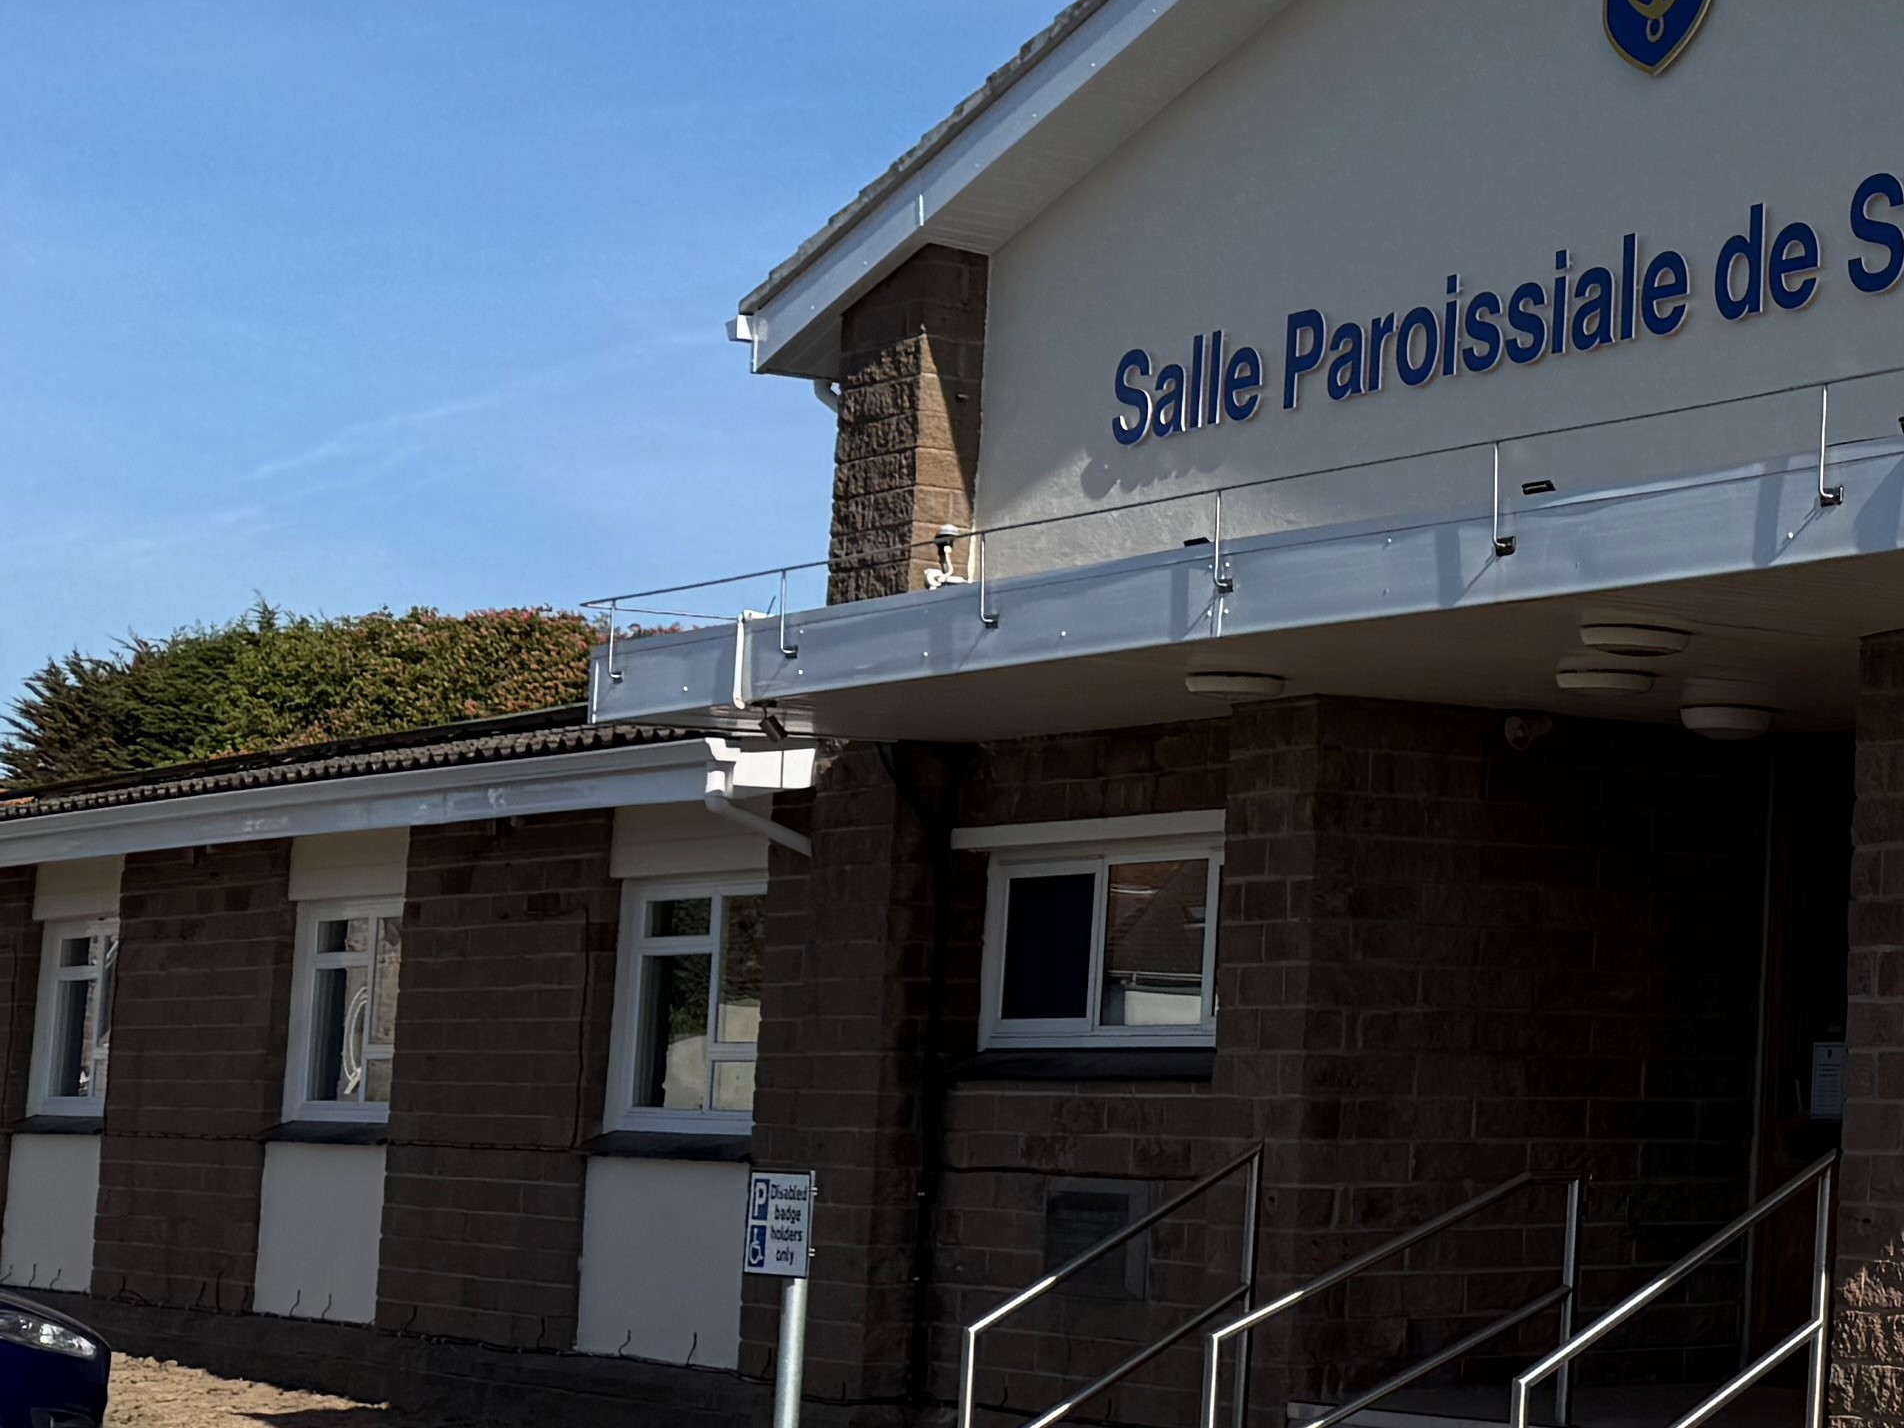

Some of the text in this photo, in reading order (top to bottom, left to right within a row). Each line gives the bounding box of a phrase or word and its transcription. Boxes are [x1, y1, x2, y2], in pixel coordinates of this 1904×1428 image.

[1112, 329, 1261, 445] Salle
[1285, 248, 1688, 408] Paroissiale
[1715, 202, 1818, 320] de
[770, 1184, 807, 1201] Disabled
[774, 1204, 801, 1224] badge
[770, 1225, 803, 1242] holders
[776, 1247, 794, 1266] only
